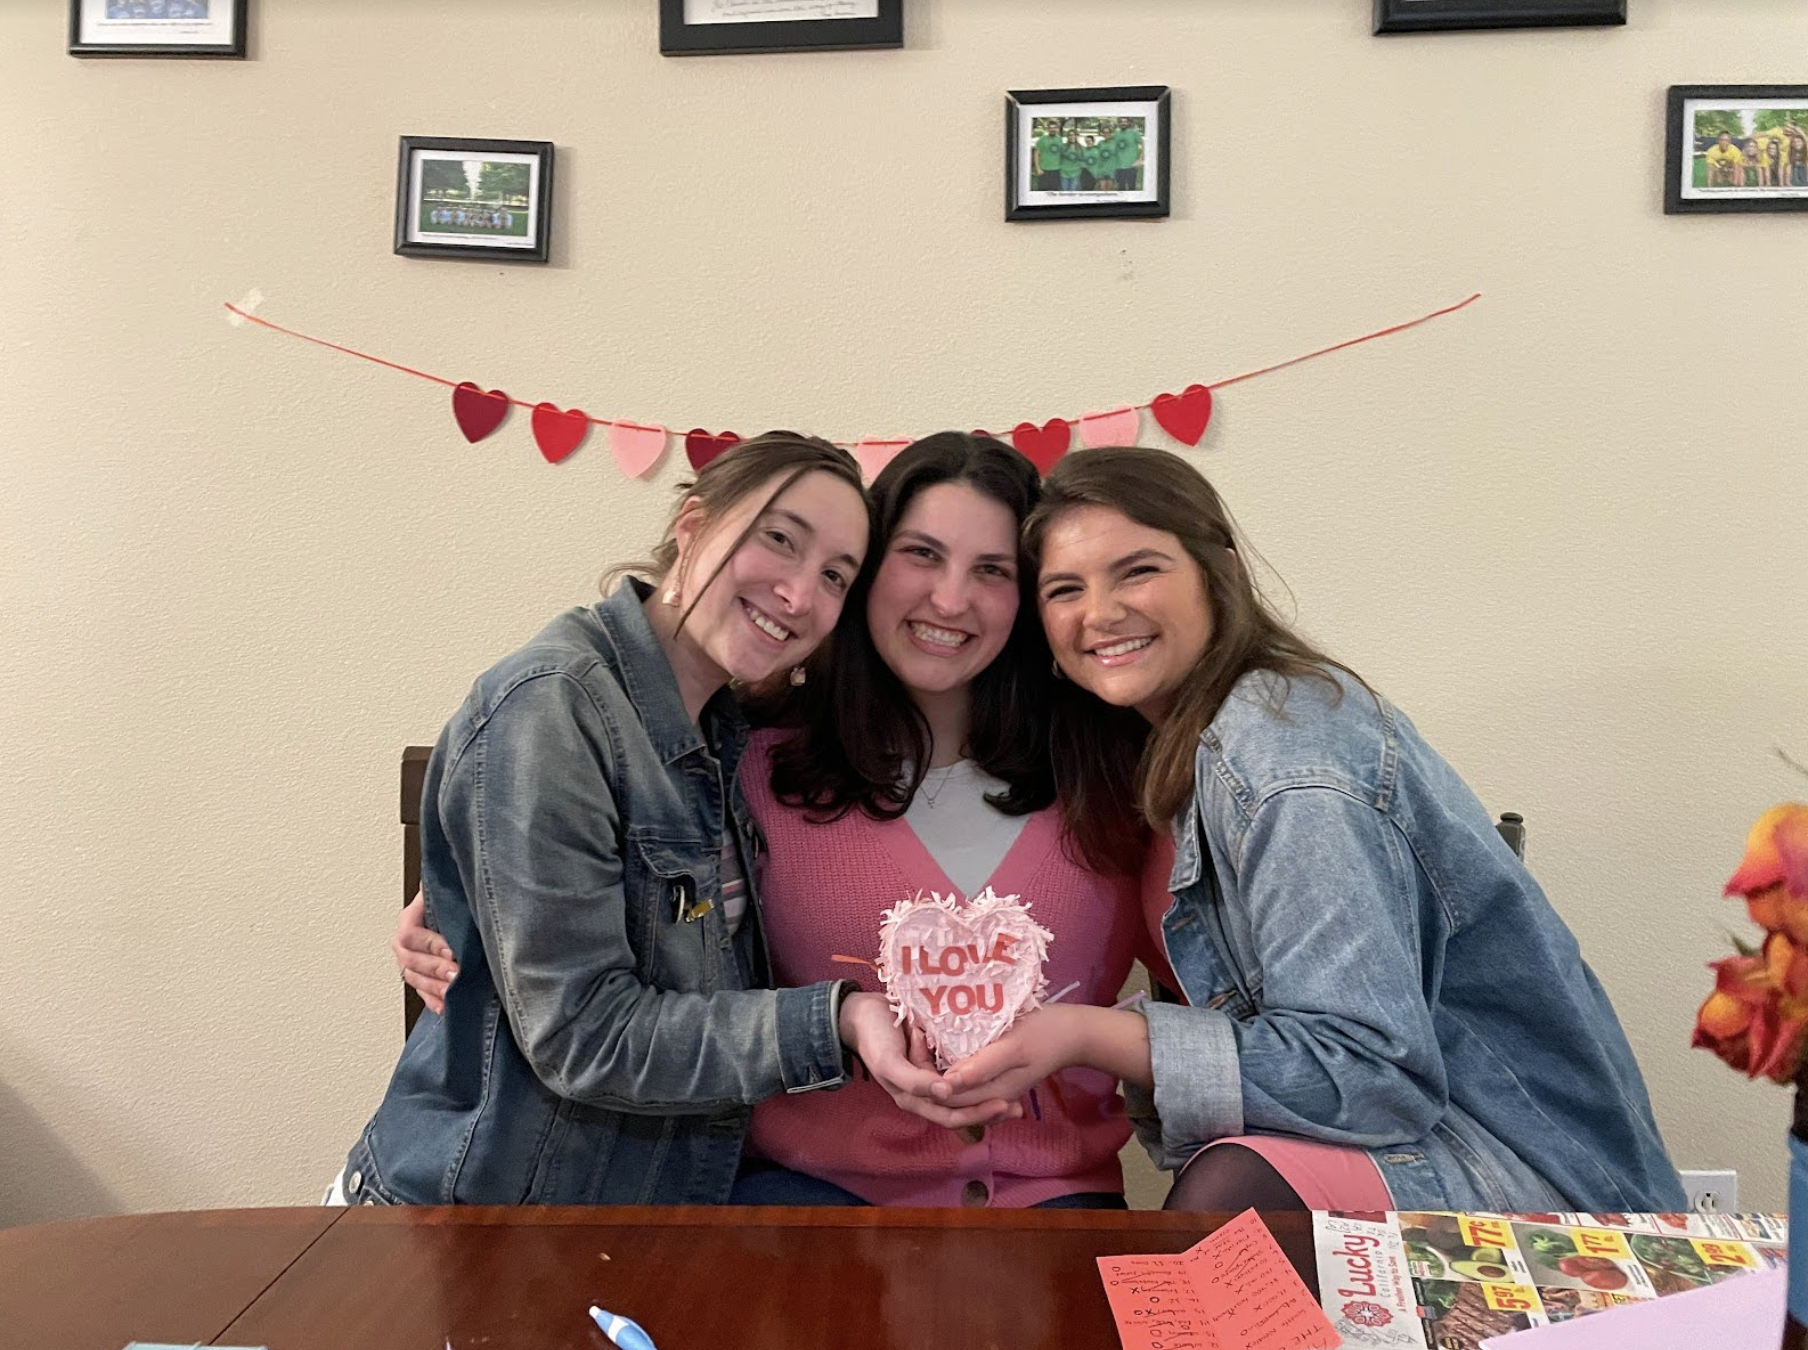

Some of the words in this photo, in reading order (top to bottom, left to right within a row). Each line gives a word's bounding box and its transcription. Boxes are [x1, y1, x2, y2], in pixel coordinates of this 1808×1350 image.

[902, 946, 912, 975] I
[919, 932, 1020, 976] LOVE
[920, 983, 1004, 1015] YOU
[1332, 1234, 1380, 1297] Lucky
[1375, 1250, 1391, 1299] California
[1291, 1322, 1322, 1347] THE
